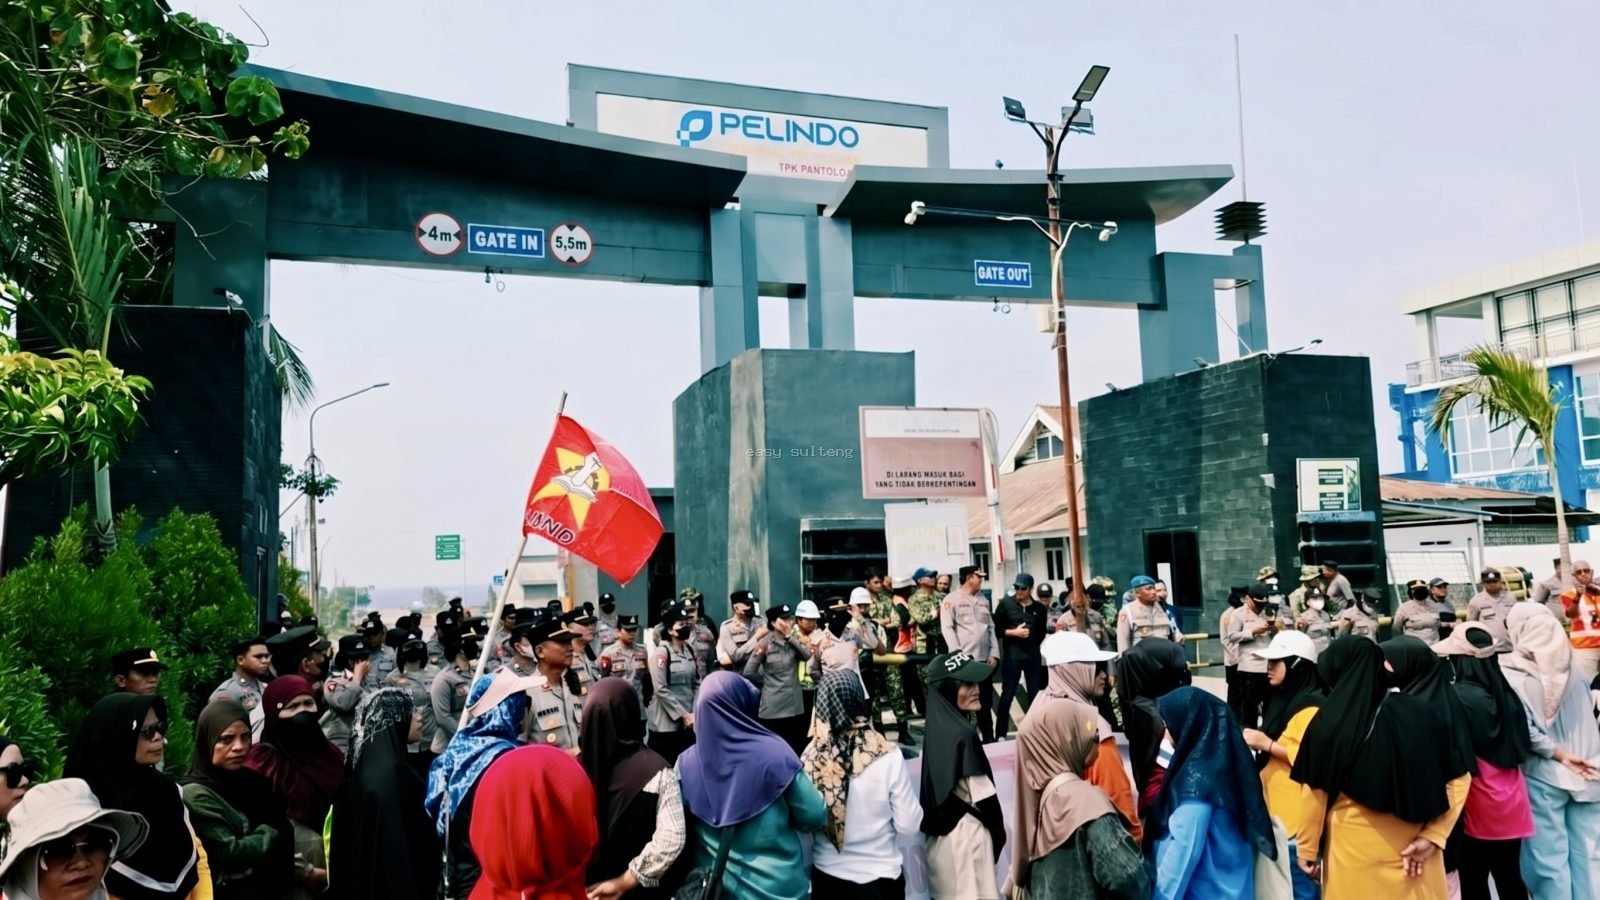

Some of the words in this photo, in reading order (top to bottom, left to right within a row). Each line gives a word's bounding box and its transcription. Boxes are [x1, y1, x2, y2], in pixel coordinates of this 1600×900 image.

[719, 112, 860, 149] PELINDO
[779, 162, 798, 173] TPK
[475, 230, 517, 250] GATE
[521, 234, 538, 251] IN
[555, 235, 587, 251] 5,5m
[978, 266, 1005, 280] GATE
[1007, 267, 1028, 281] OUT
